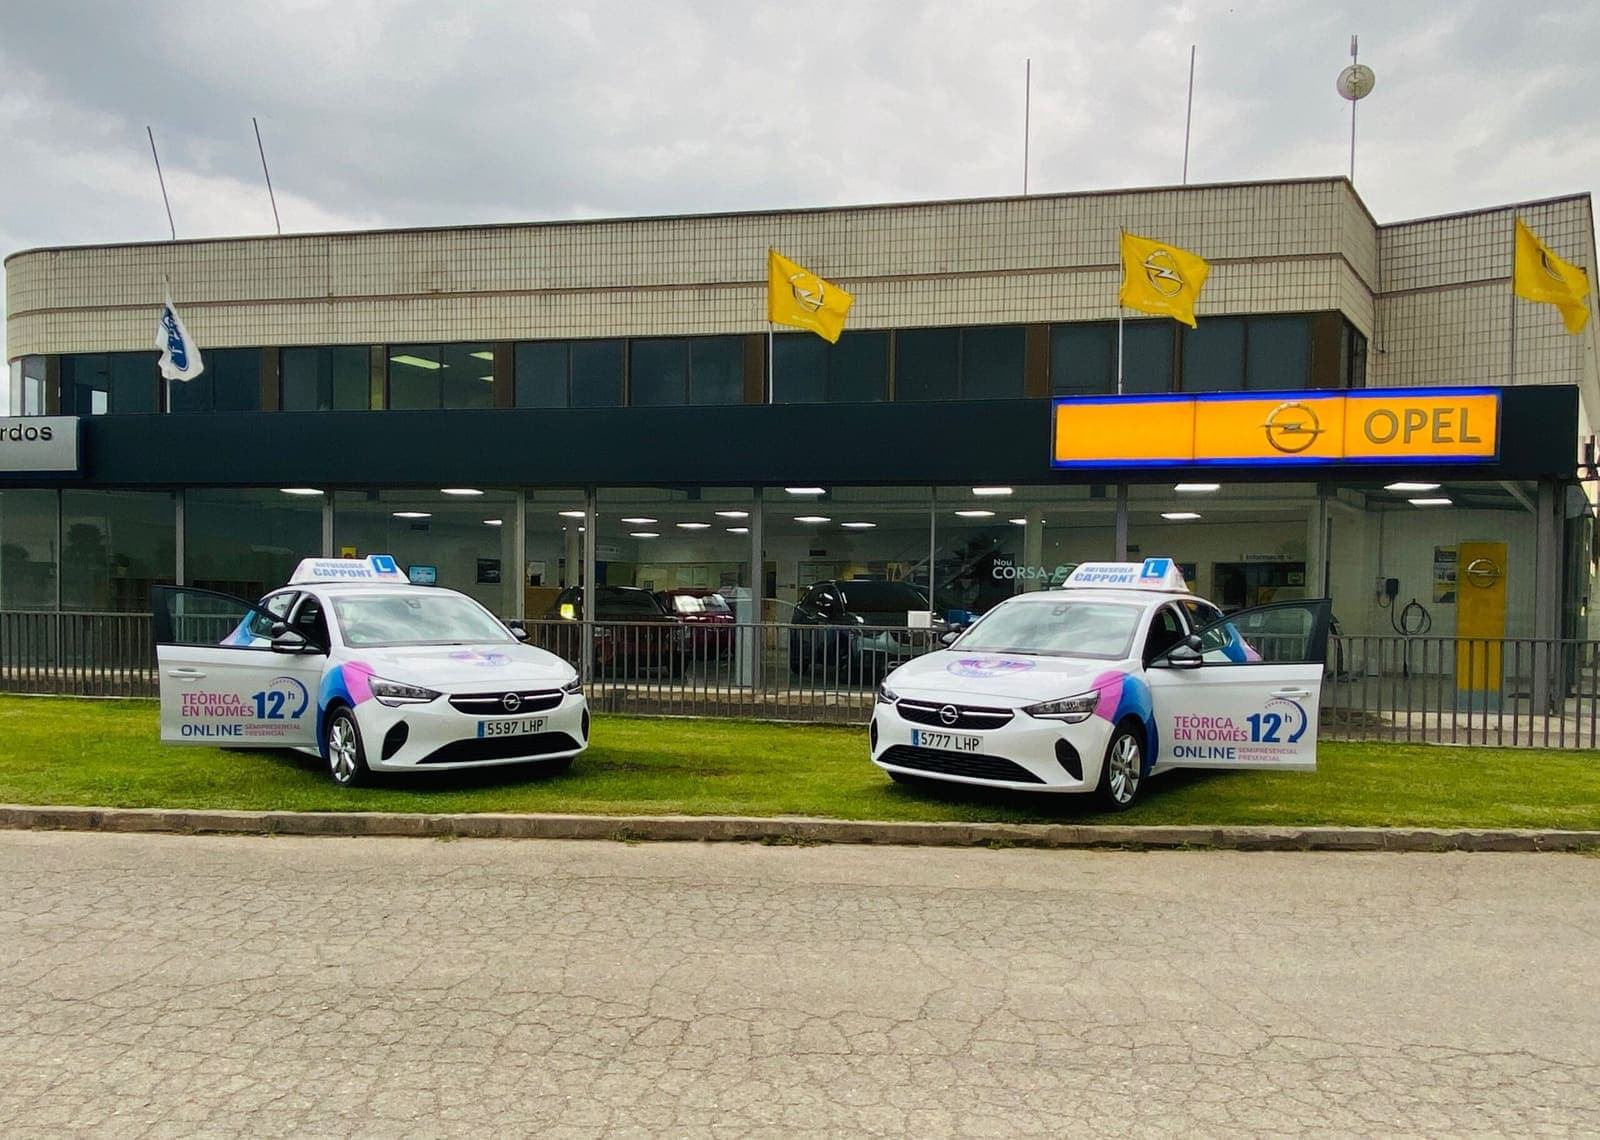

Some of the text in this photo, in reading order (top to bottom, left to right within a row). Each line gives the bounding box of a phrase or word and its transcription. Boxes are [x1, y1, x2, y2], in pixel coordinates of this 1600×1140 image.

[1364, 408, 1482, 444] OPEL
[378, 559, 391, 572] L
[993, 558, 1012, 566] Nou
[313, 568, 372, 578] CAPPONT
[1146, 562, 1159, 577] L
[1074, 573, 1136, 583] CAPPONT
[181, 691, 241, 705] TEÒRICA
[182, 702, 255, 717] EN NOMÉS
[487, 719, 544, 736] 5597 LHP
[1174, 713, 1234, 729] TEÒRICA
[181, 724, 243, 737] ONLINE
[1174, 725, 1248, 742] EN NOMÉS
[920, 732, 980, 752] 5777 LHP
[1173, 746, 1236, 759] ONLINE
